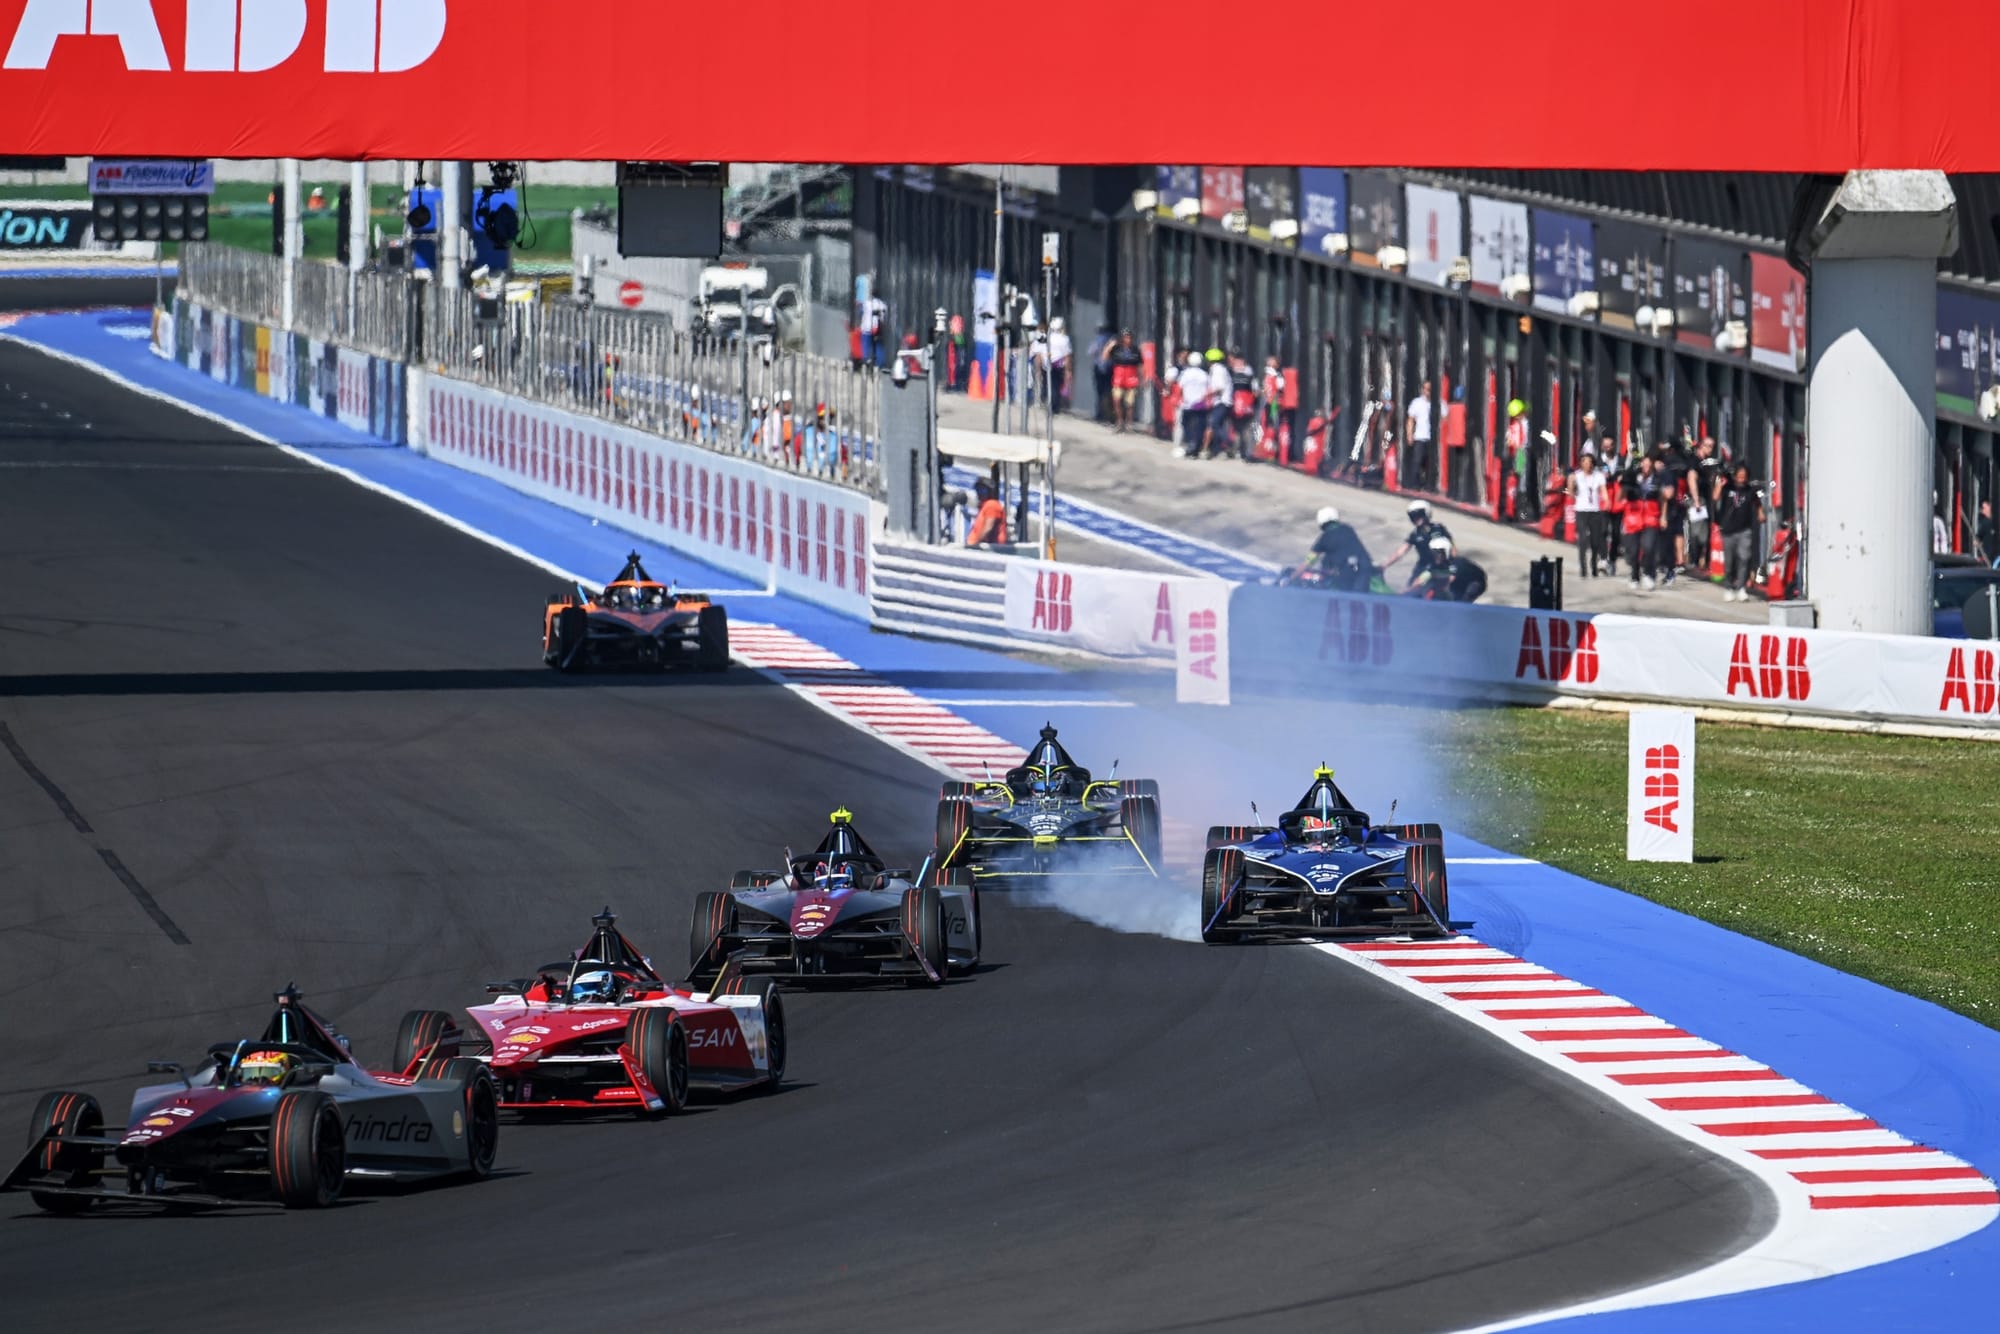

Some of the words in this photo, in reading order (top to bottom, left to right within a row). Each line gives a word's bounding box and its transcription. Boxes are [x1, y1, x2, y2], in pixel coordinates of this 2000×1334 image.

[1032, 569, 1073, 633] ABB
[1319, 599, 1394, 667] ABB
[1188, 609, 1217, 681] ABB
[1516, 615, 1599, 684] ABB
[1726, 632, 1811, 701] ABB
[1939, 646, 2000, 714] AB
[1644, 743, 1680, 834] ABB
[684, 1027, 739, 1048] SAN
